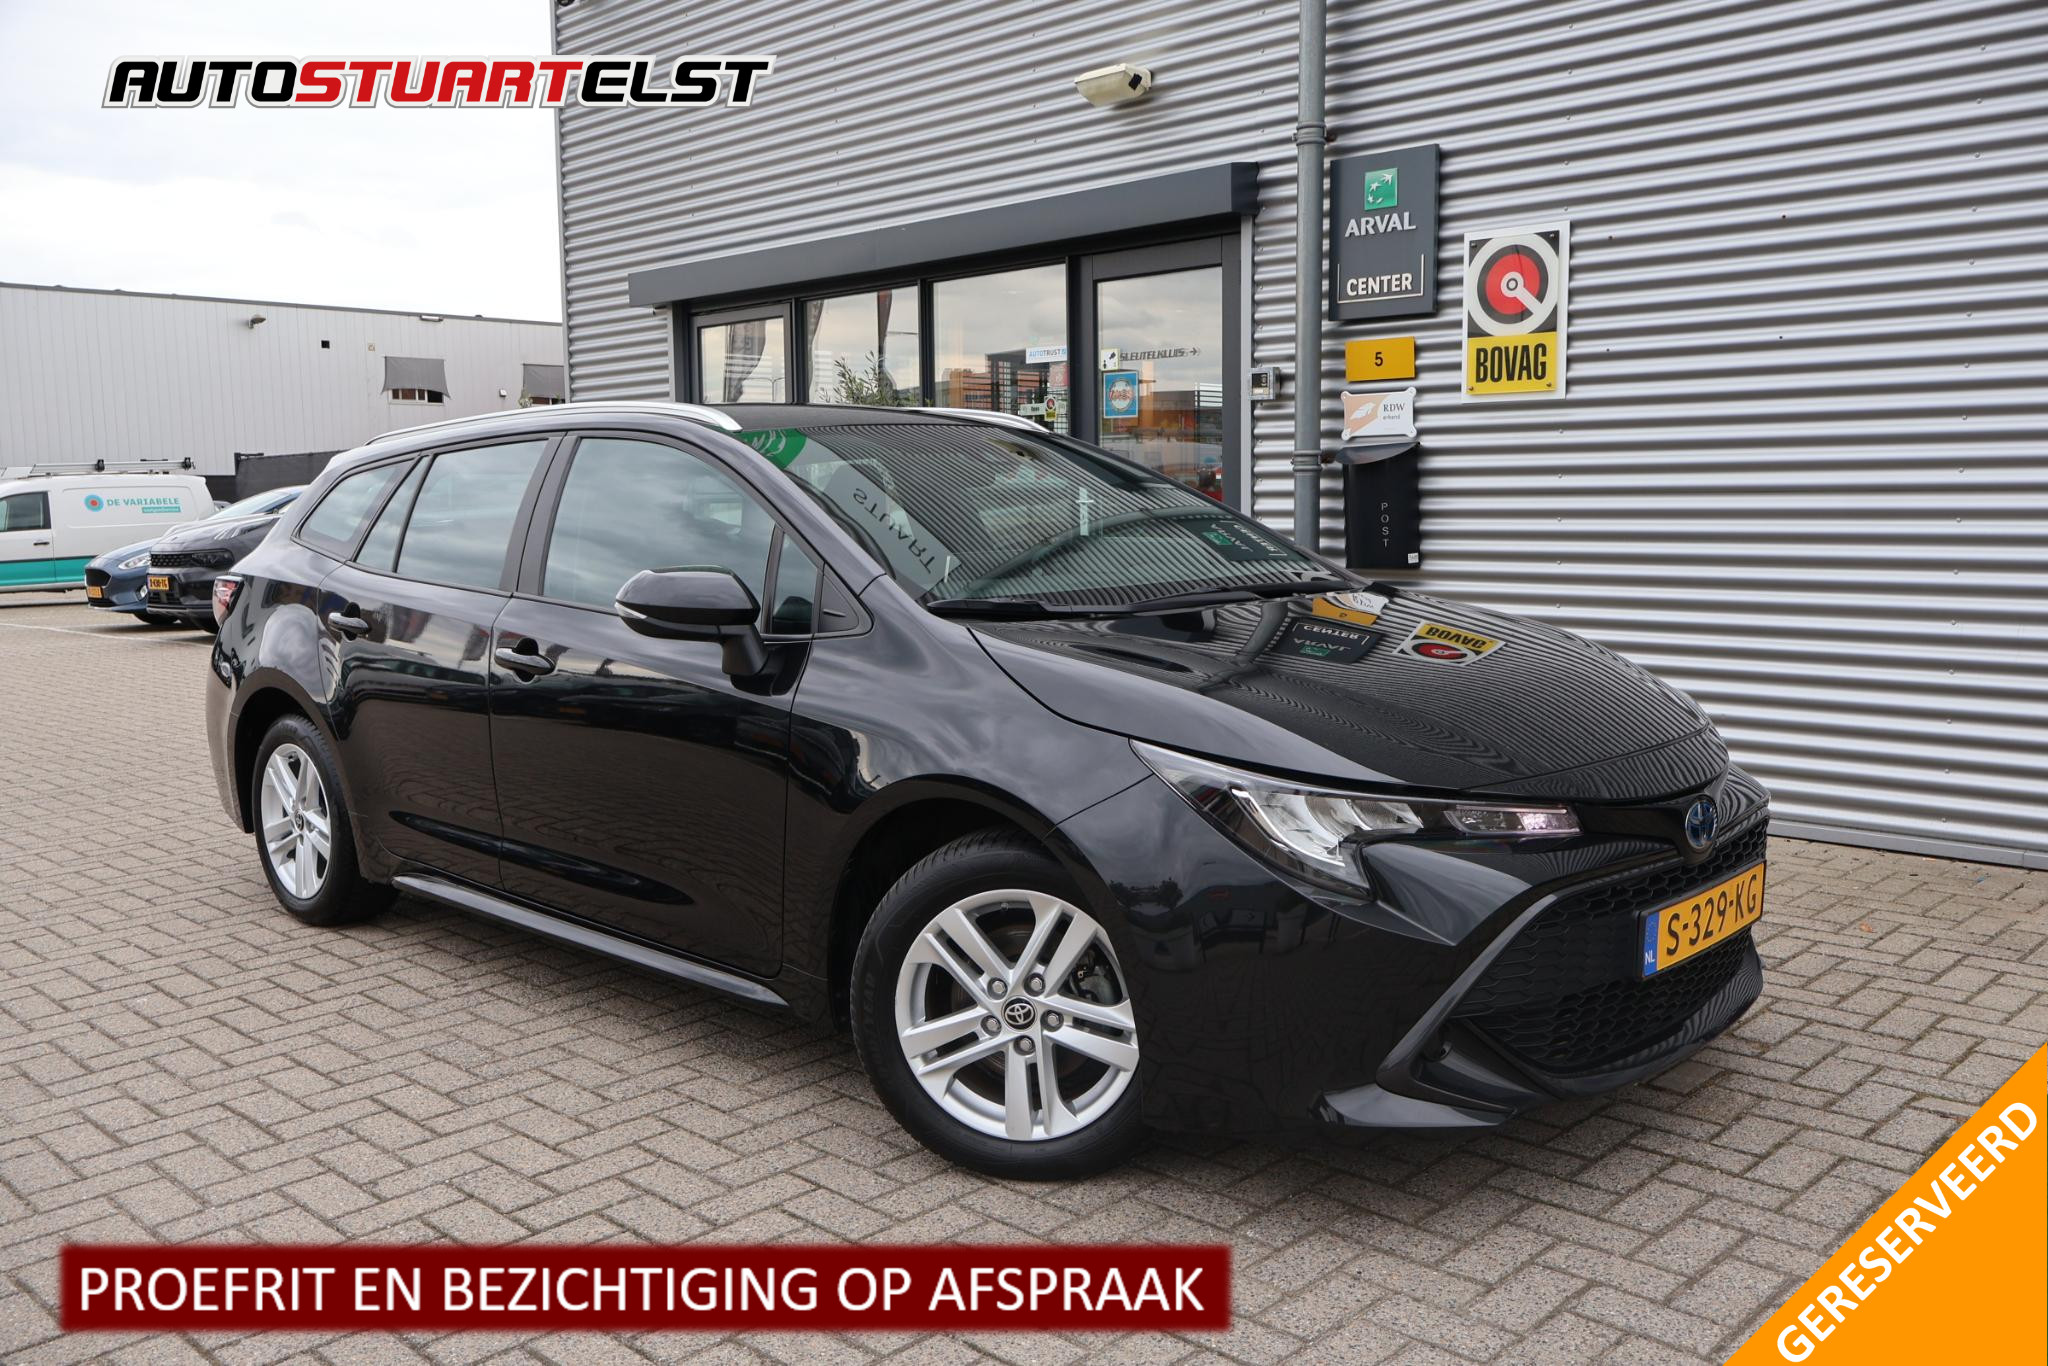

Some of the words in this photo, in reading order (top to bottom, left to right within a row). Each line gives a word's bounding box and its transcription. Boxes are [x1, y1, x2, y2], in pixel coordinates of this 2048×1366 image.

[1344, 211, 1417, 238] ARVAL
[1346, 272, 1413, 296] CENTER
[1374, 351, 1384, 367] 5
[1475, 342, 1548, 384] BOVAG
[1383, 402, 1406, 412] RDW
[106, 499, 121, 507] DE
[1380, 501, 1390, 548] POST
[1666, 873, 1757, 956] S-329-KG
[1644, 949, 1656, 965] NL
